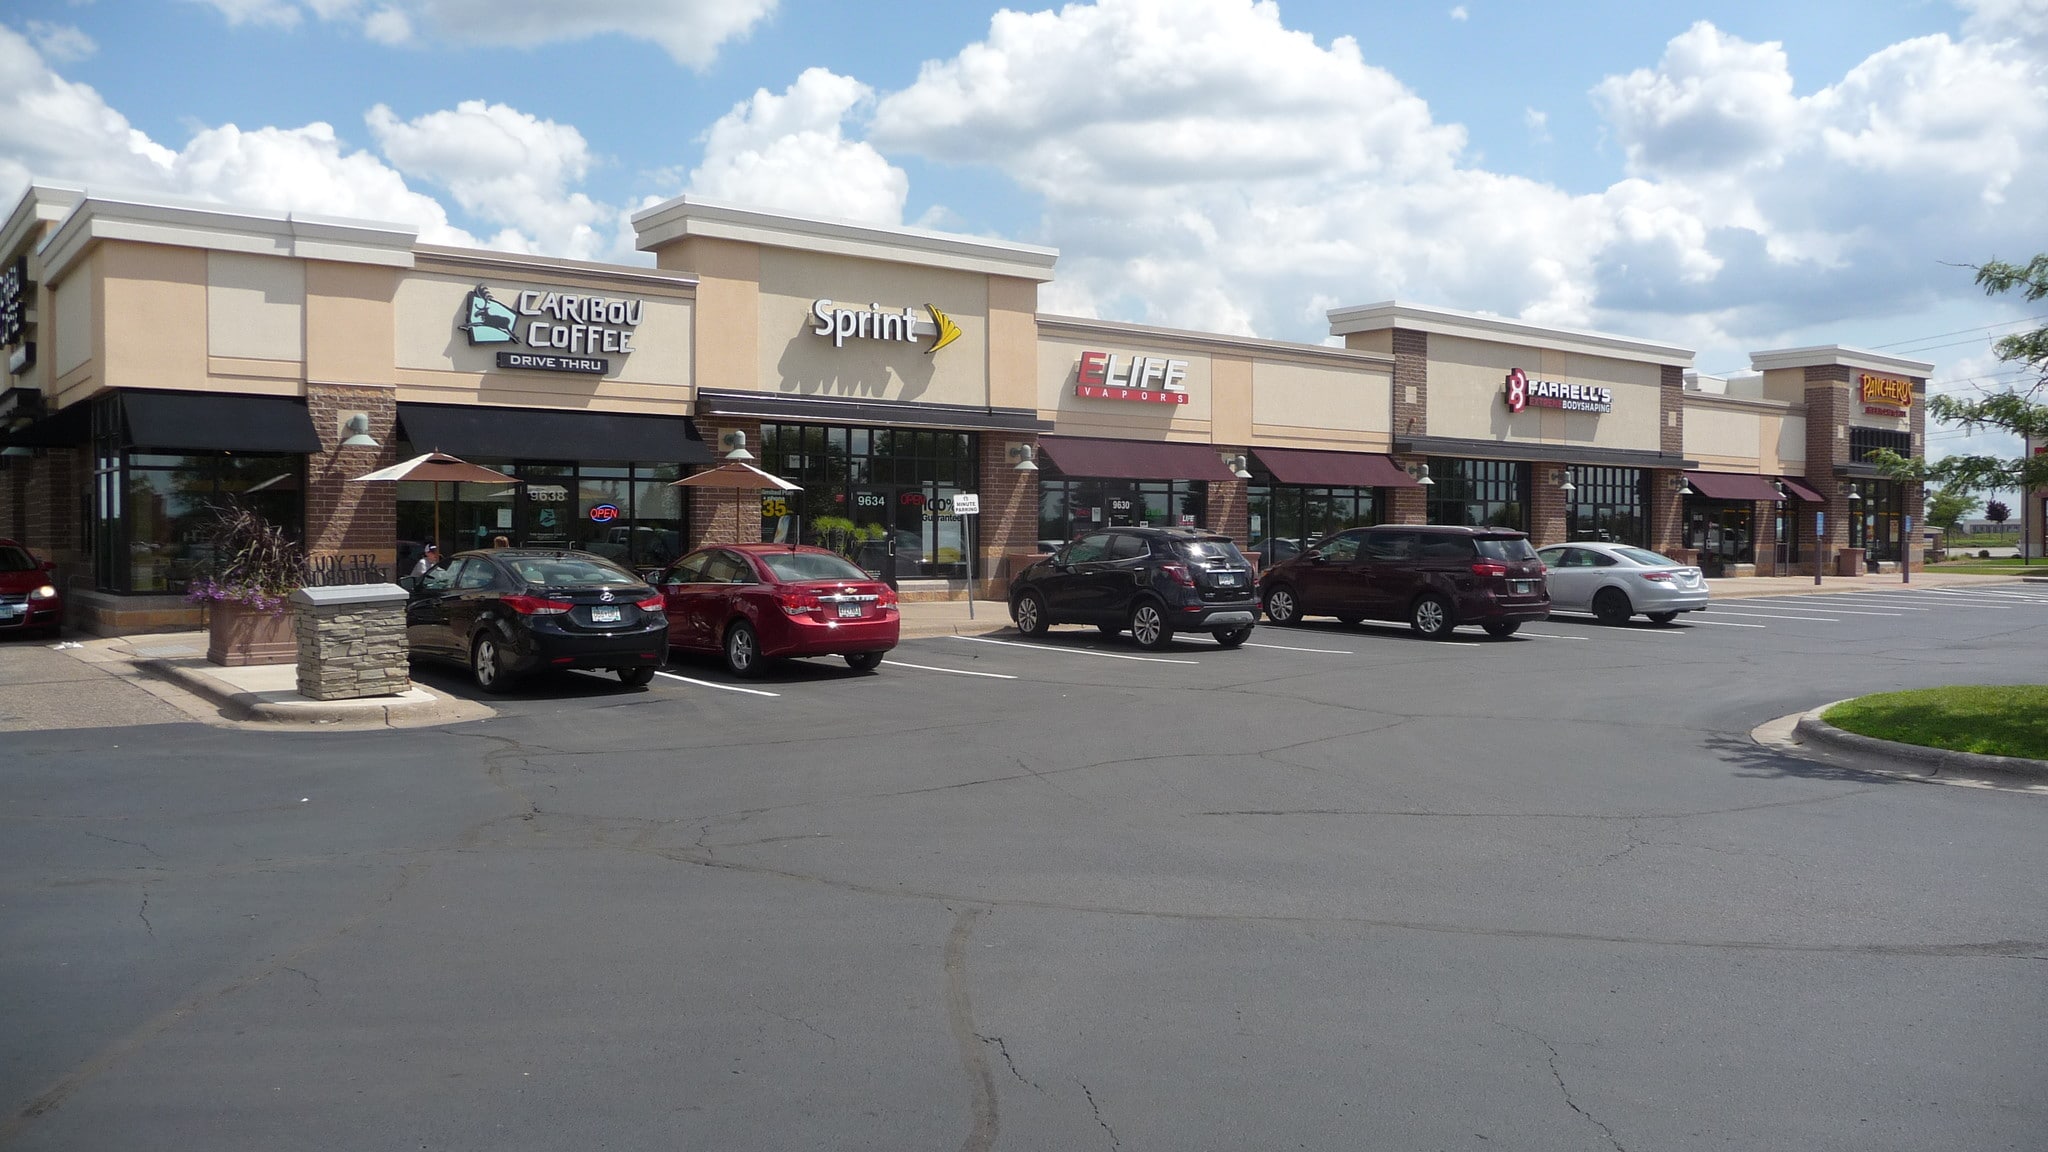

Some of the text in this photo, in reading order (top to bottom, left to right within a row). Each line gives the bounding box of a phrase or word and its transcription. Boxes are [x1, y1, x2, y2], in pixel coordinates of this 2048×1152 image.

[518, 290, 645, 327] CARIBOU
[813, 299, 918, 348] Sprint
[527, 321, 637, 354] COFFEE
[509, 355, 602, 371] DRIVE THRU
[1078, 351, 1189, 391] ELIFE
[1084, 386, 1184, 403] VAPORS
[1527, 379, 1612, 403] FARRELL'S
[1863, 374, 1913, 407] PANCHEROS
[1562, 399, 1611, 413] BODYSHAPING
[530, 490, 566, 501] 9638
[857, 496, 886, 506] 9634
[762, 499, 787, 517] 35
[1112, 500, 1131, 510] 9630
[590, 508, 619, 520] OPEN
[922, 513, 961, 521] Gurantee
